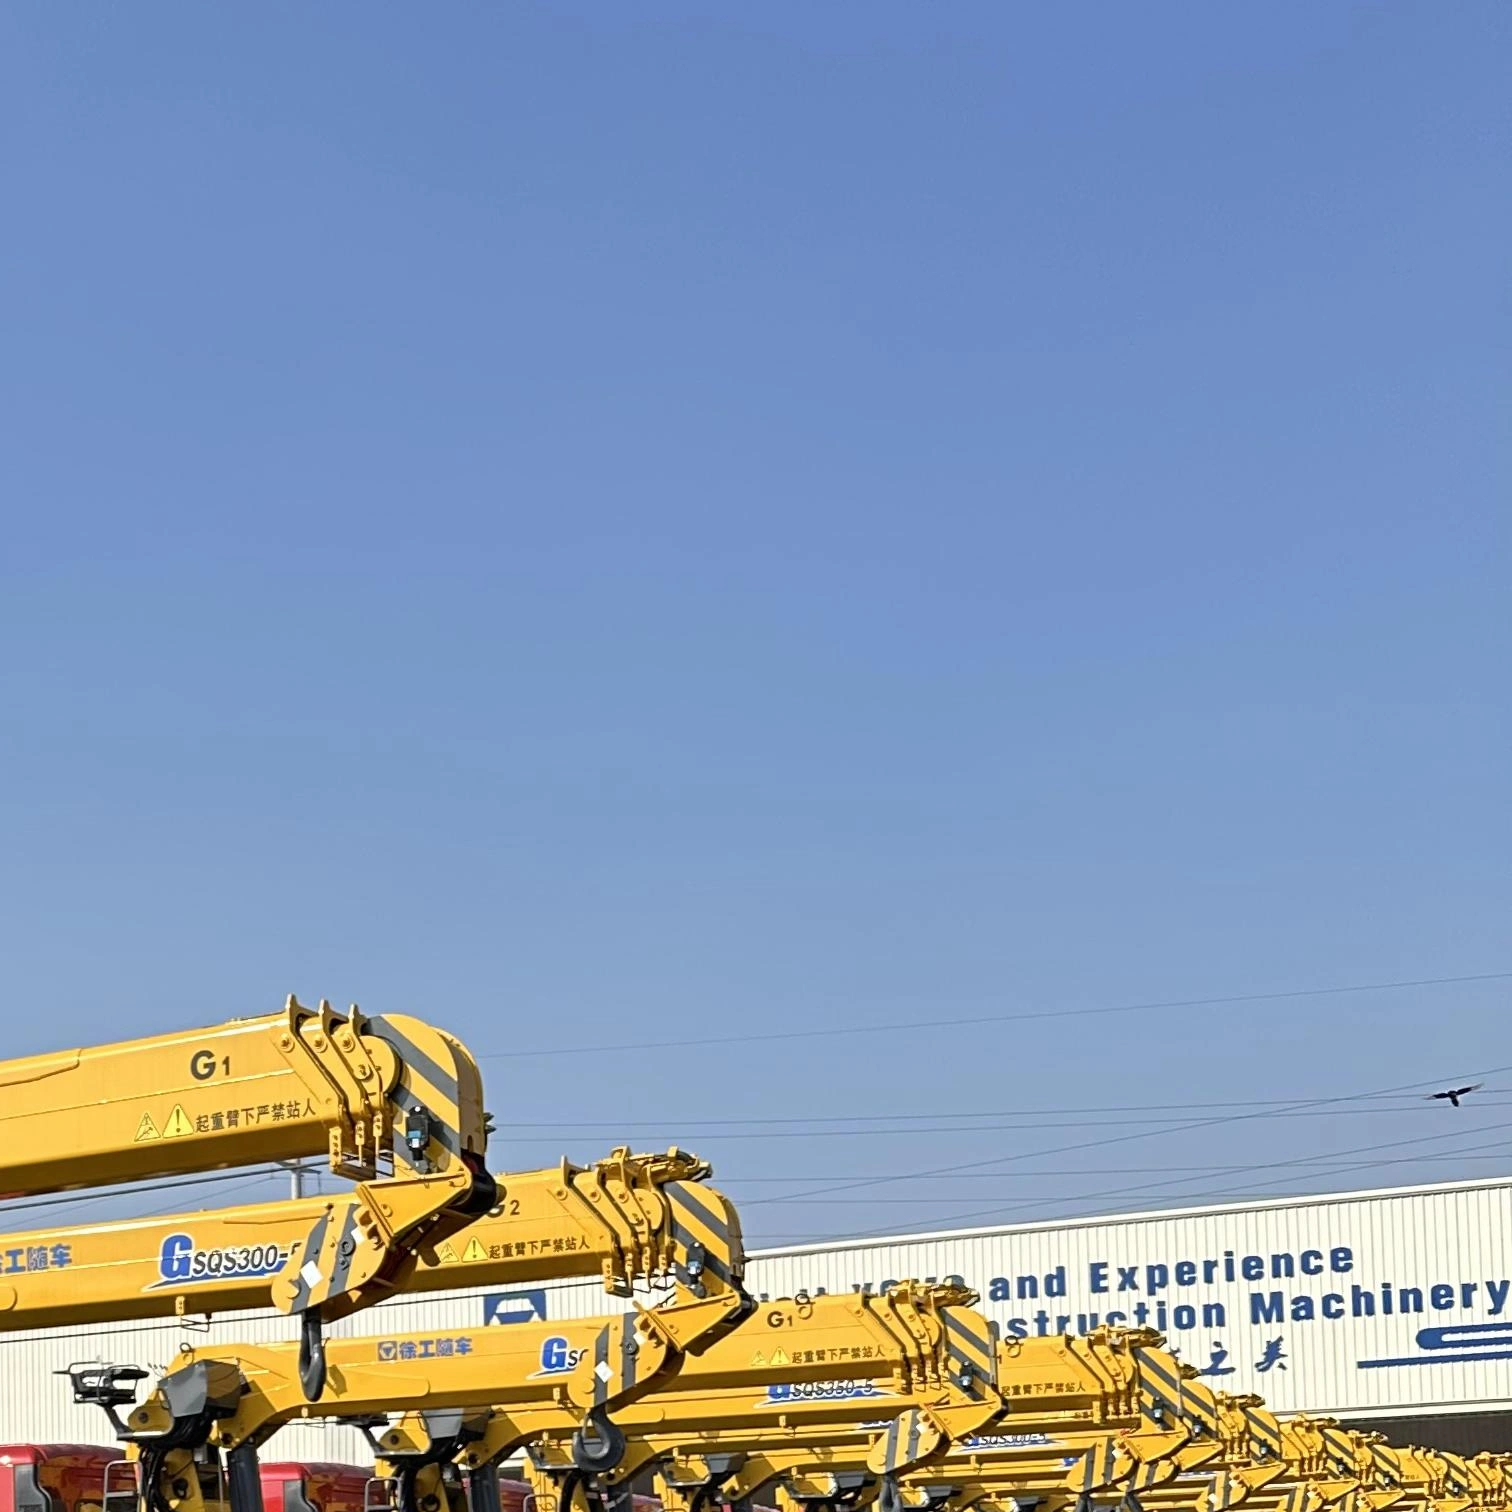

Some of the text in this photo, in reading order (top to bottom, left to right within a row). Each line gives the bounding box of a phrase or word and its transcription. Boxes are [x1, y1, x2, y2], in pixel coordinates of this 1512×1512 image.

[190, 1049, 231, 1081] G1
[195, 1097, 317, 1134] 起重臂下严禁站人
[489, 1234, 591, 1260] 起重臂下严禁站人
[988, 1265, 1067, 1302] and
[1089, 1246, 1354, 1297] Experience
[1249, 1280, 1511, 1326] Machinery
[766, 1310, 794, 1329] G1
[791, 1343, 886, 1364] 起重臂下严禁站人
